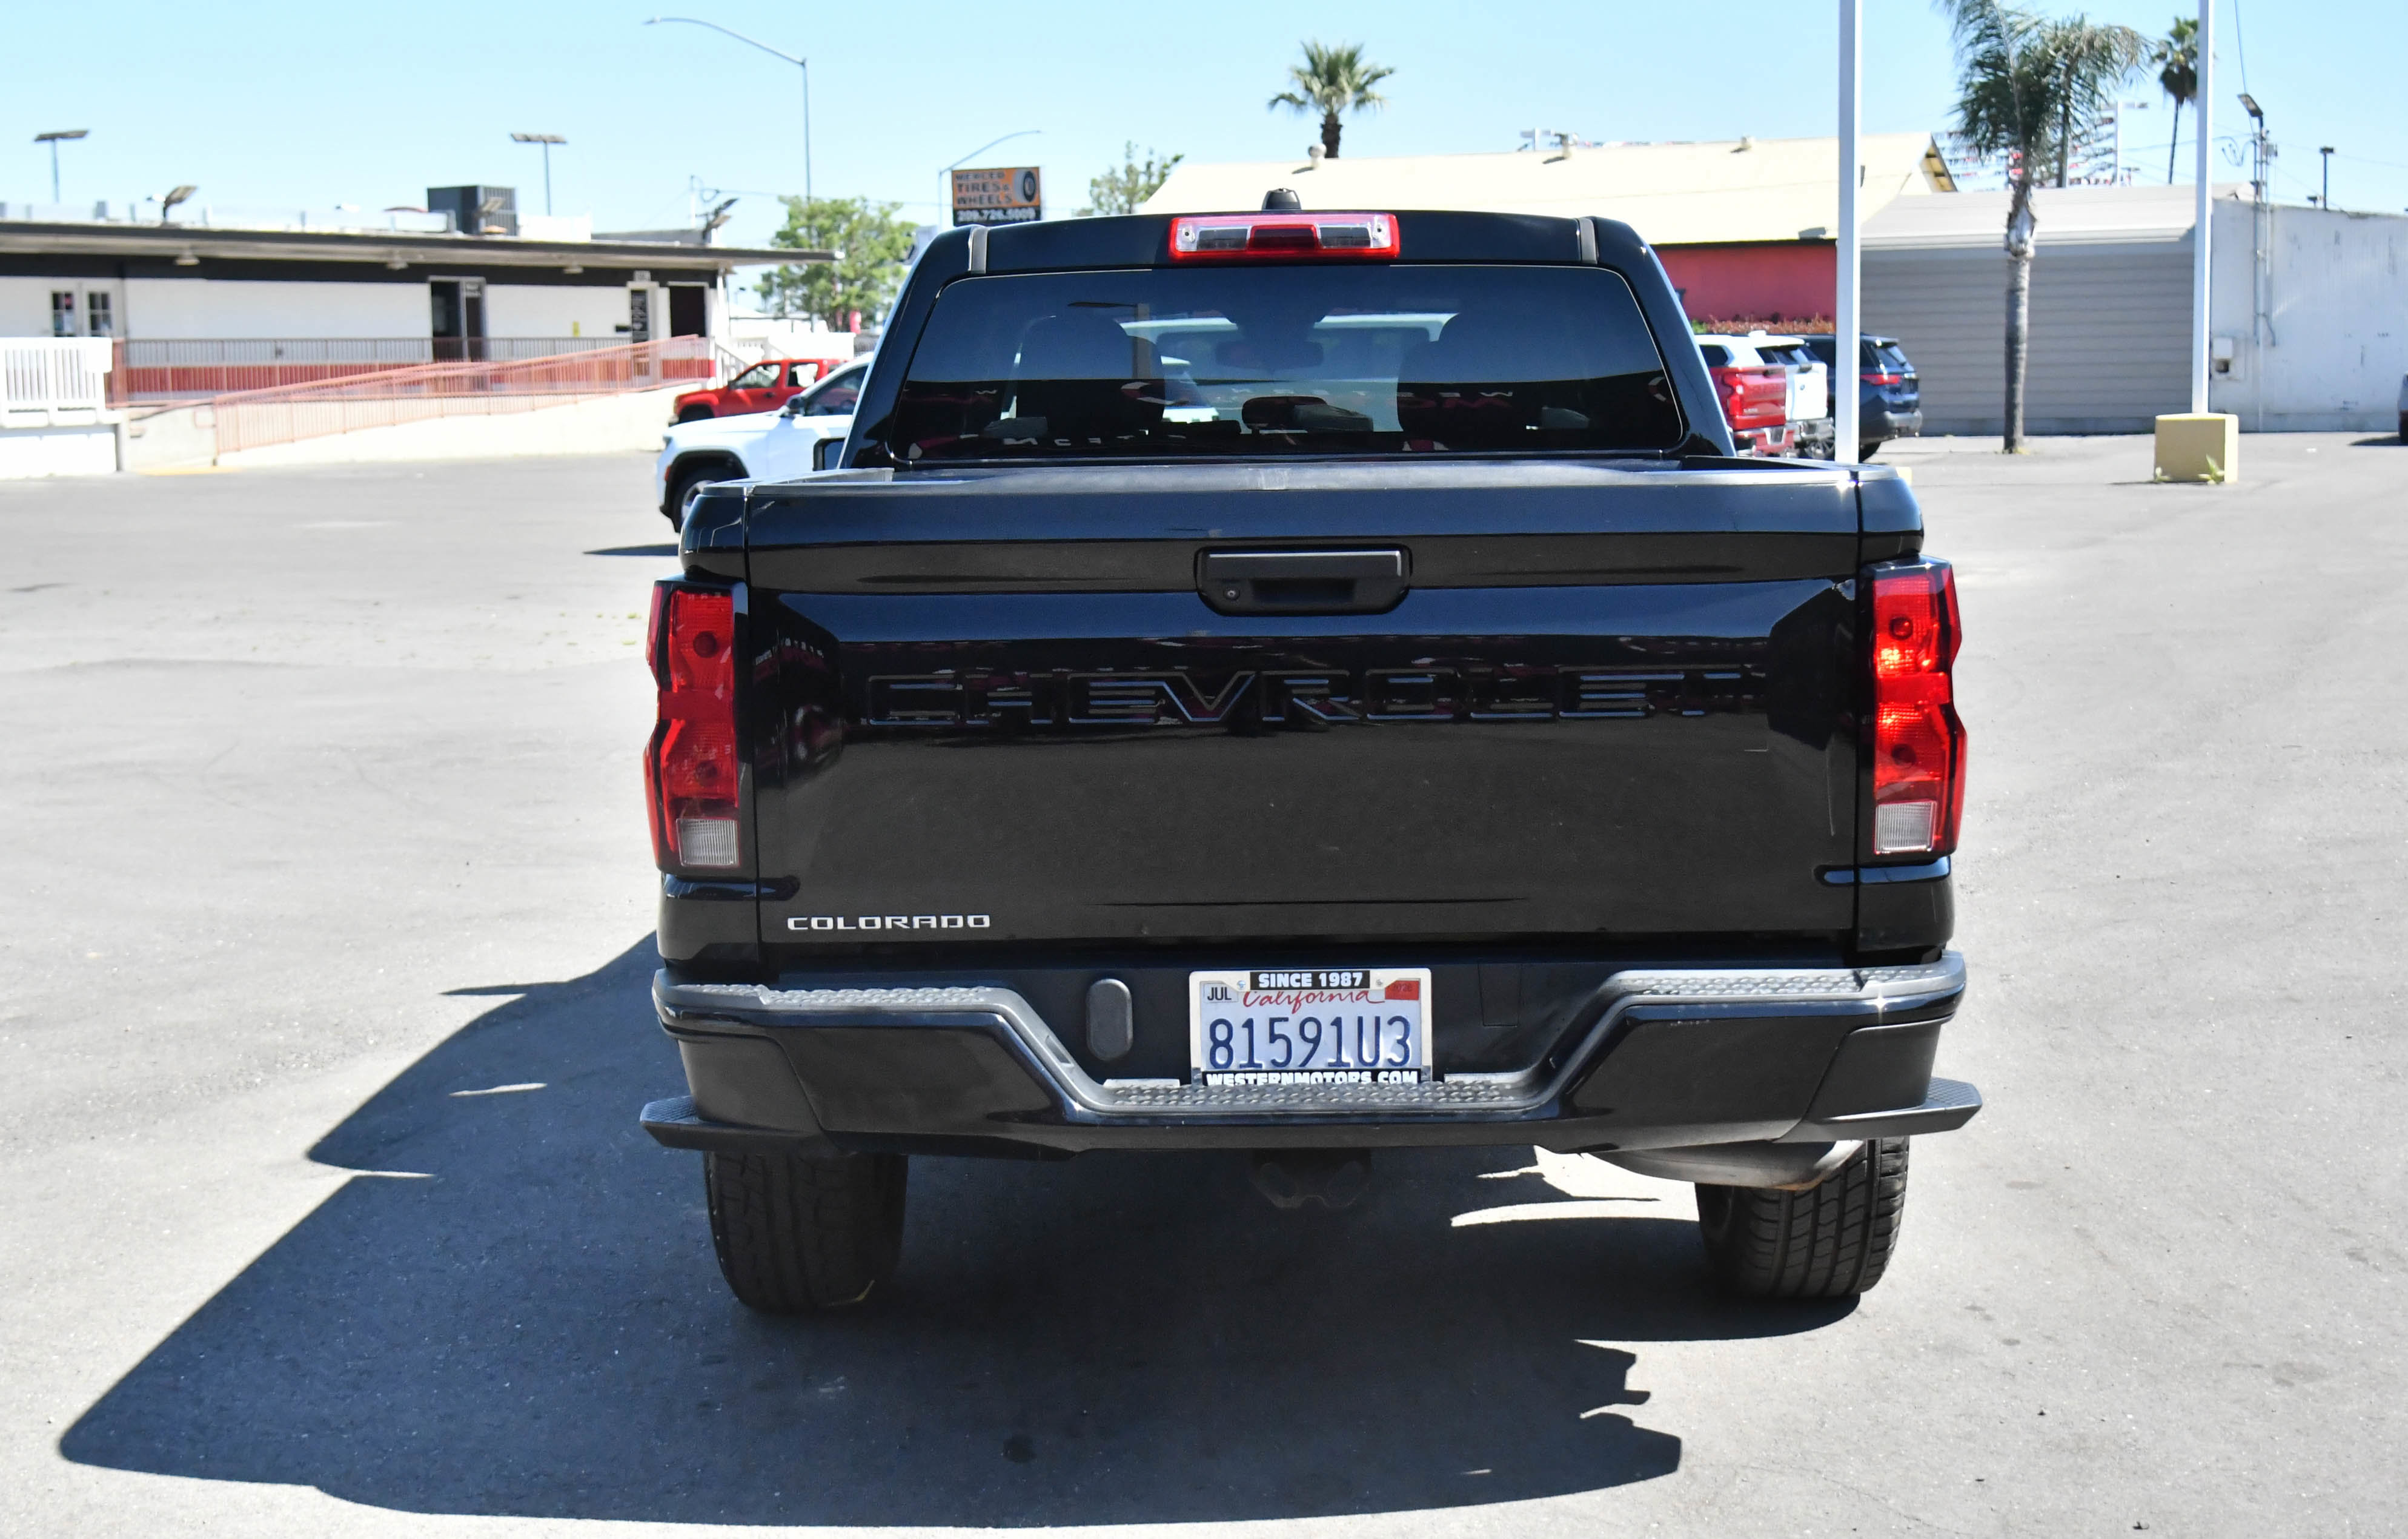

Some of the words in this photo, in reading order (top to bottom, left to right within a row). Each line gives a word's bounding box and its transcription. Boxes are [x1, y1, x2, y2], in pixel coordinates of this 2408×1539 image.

[957, 194, 1012, 205] WHEELS
[868, 665, 1741, 725] CHEVROLET
[787, 915, 990, 930] COLORADO
[1258, 973, 1312, 987] SINCE
[1319, 972, 1363, 987] 1987
[1207, 987, 1232, 1001] JUL
[1242, 990, 1385, 1014] California
[1209, 1015, 1411, 1069] 81591U3
